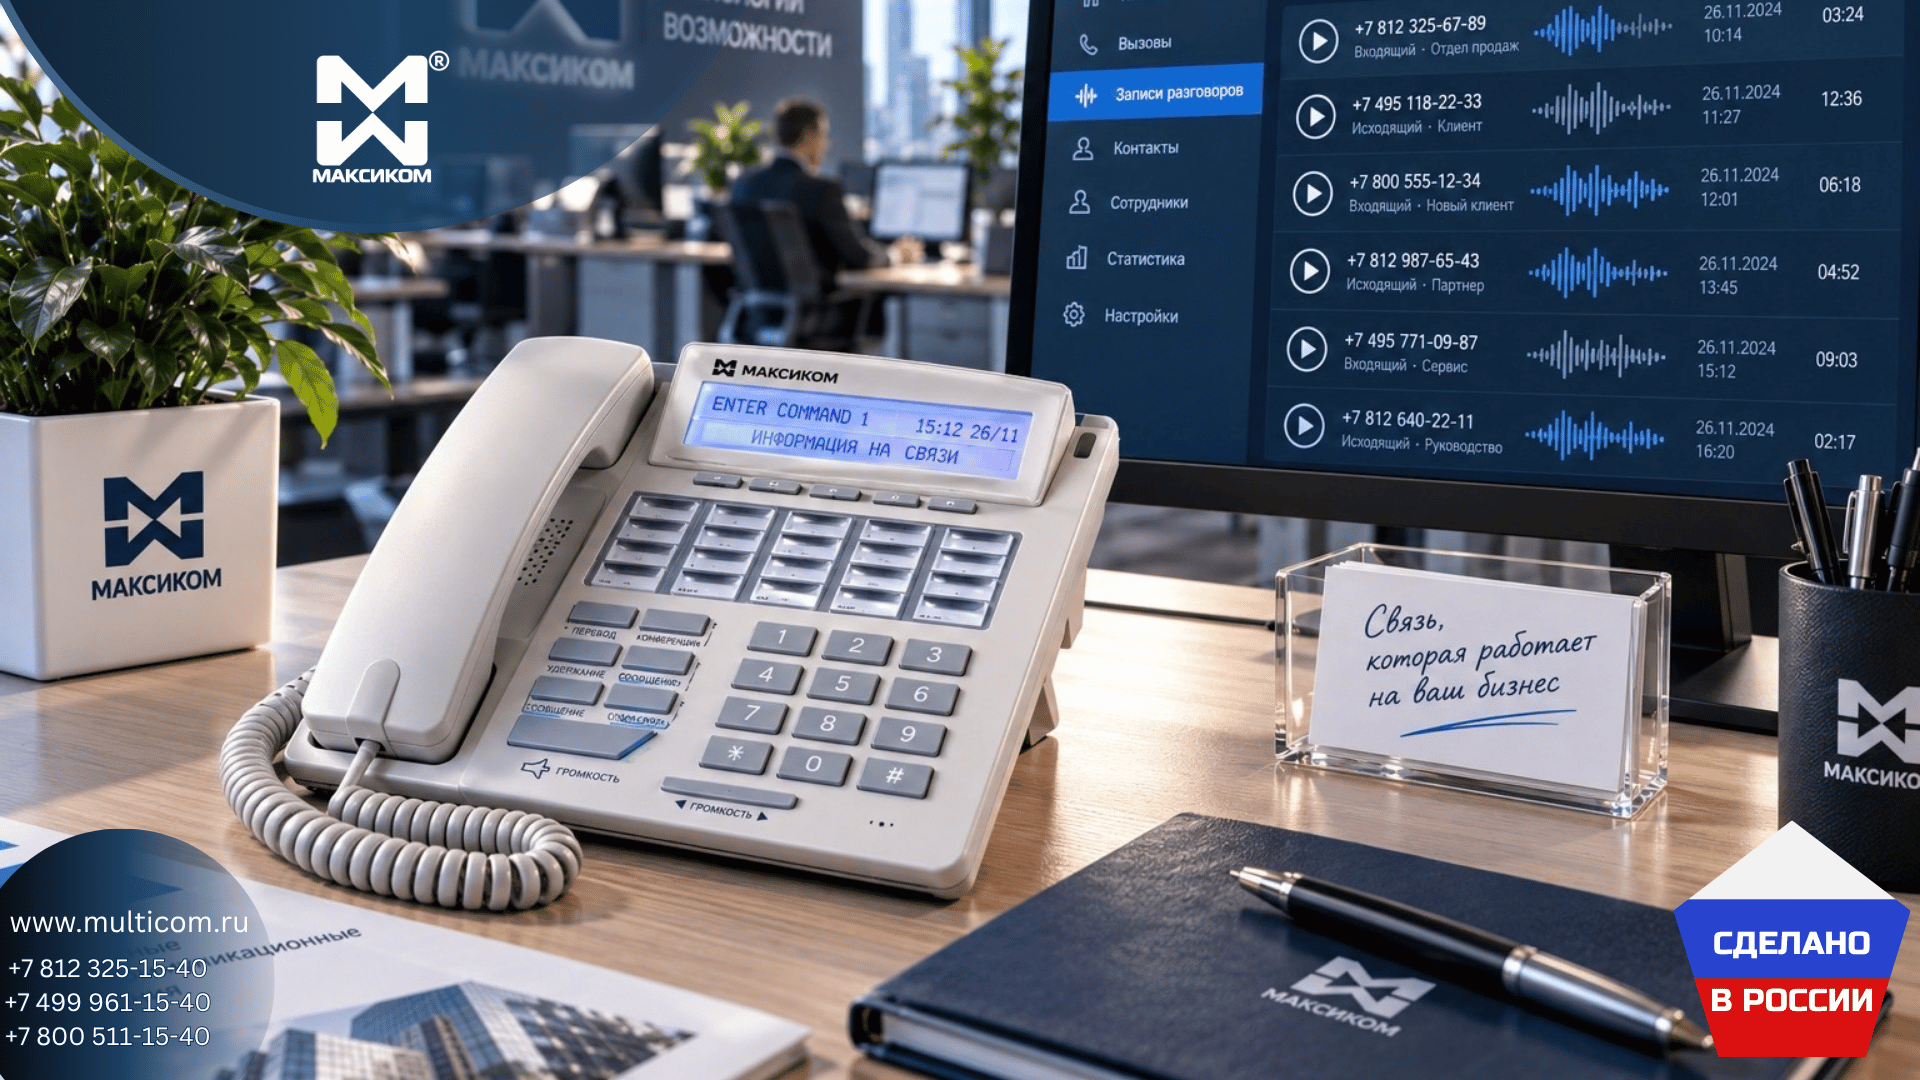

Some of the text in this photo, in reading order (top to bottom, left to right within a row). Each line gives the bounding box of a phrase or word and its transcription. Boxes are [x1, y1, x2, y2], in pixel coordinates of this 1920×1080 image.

[1704, 1, 1783, 20] 26.11.2024
[1822, 5, 1865, 24] 03:24
[1355, 14, 1487, 36] +7 812 325-67-89
[664, 11, 832, 58] ВОЗМОЖНОСТИ
[1118, 36, 1172, 51] Вызовы
[1704, 26, 1743, 43] 10:14
[1354, 41, 1520, 60] Входящий Отдел продаж
[459, 48, 635, 90] МАКСИКОМ
[1115, 85, 1244, 103] Записи разговоров
[1702, 84, 1781, 101] 26.11.2024
[1821, 89, 1863, 107] 12:36
[1352, 92, 1482, 112] +7 495 118-22-33
[1702, 109, 1742, 125] 11:27
[1352, 119, 1483, 136] Исходящий Клиент
[1113, 140, 1179, 155] Контакты
[1350, 172, 1481, 190] +7 800 555-12-34
[1700, 166, 1780, 183] 26.11.2024
[1819, 175, 1861, 193] 06:18
[1110, 195, 1189, 213] Сотрудники
[1349, 198, 1515, 215] Входящий Новый клиент
[1701, 191, 1738, 207] 12:01
[1107, 250, 1186, 266] Статистика
[1347, 252, 1480, 269] +7 812 987-65-43
[1699, 255, 1778, 271] 26.11.2024
[1817, 263, 1860, 281] 04:52
[1346, 277, 1485, 296] Исходящий Партнер
[1700, 279, 1738, 295] 13:45
[1104, 308, 1179, 327] Настройки
[1344, 331, 1479, 351] +7 495 771-09-87
[1697, 339, 1777, 356] 26.11.2024
[1344, 356, 1469, 376] Входящий Сервис
[1815, 350, 1858, 369] 09:03
[741, 364, 839, 385] МАКСИКОМ
[1698, 363, 1736, 379] 15:12
[711, 395, 869, 427] ENTER COMMAND 1
[1342, 409, 1473, 430] +7 812 640-22-11
[915, 418, 1018, 444] 15:12 26/11
[1695, 419, 1775, 437] 26.11.2024
[751, 429, 960, 465] ИНФОРМАЦИЯ НА СВЯЗИ
[1341, 434, 1503, 455] Исходящий Руководство
[1814, 432, 1856, 450] 02:17
[1696, 443, 1735, 460] 16:20
[91, 565, 222, 601] МАКСИКОМ
[1364, 603, 1444, 639] Связь,
[778, 629, 787, 644] 1
[848, 637, 865, 654] 2
[926, 646, 943, 663] 3
[1364, 629, 1599, 677] которая работает
[758, 666, 774, 683] 4
[834, 675, 852, 692] 5
[913, 685, 930, 703] 6
[1368, 670, 1560, 708] на ваш бизнес
[744, 704, 761, 721] 7
[819, 714, 837, 732] 8
[899, 725, 917, 743] 9
[805, 755, 823, 772] 0
[555, 766, 620, 784] ГРОМКОСТЬ
[885, 766, 905, 784] #
[1823, 760, 1920, 790] МАКСИКО
[689, 800, 754, 820] ГРОМКОСТЬ
[1259, 986, 1402, 1038] МАКСИКОМ
